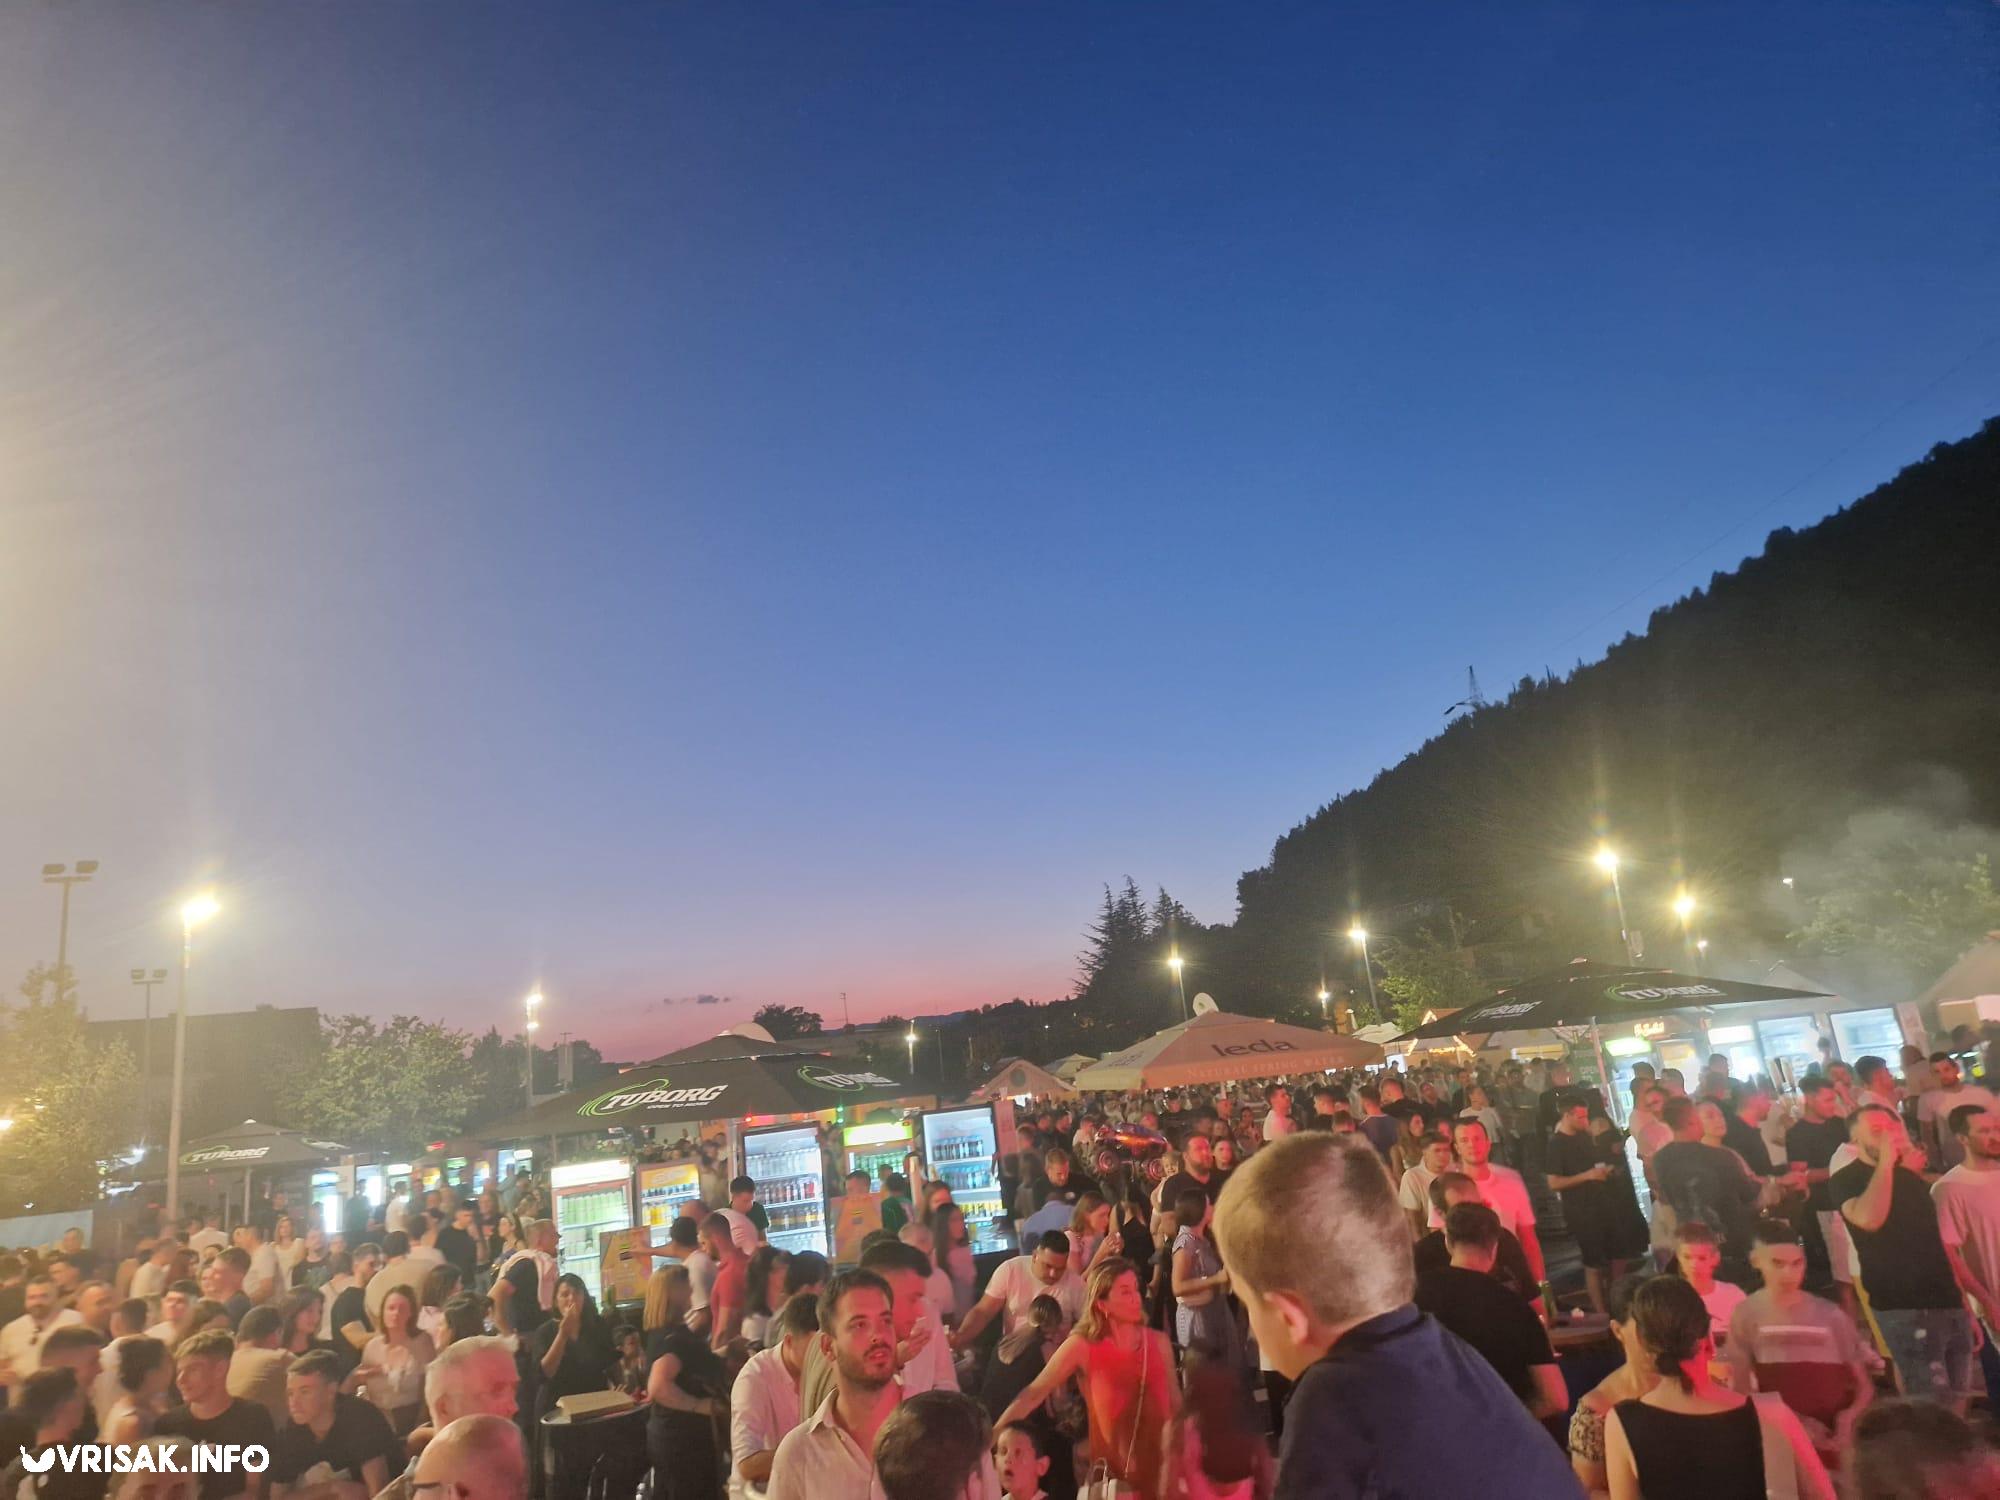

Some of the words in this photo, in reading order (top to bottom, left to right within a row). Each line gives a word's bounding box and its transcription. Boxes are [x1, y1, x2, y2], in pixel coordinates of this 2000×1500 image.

[1211, 1039, 1298, 1057] leda
[600, 1085, 728, 1110] TUBORG
[192, 1147, 270, 1162] TUBORG
